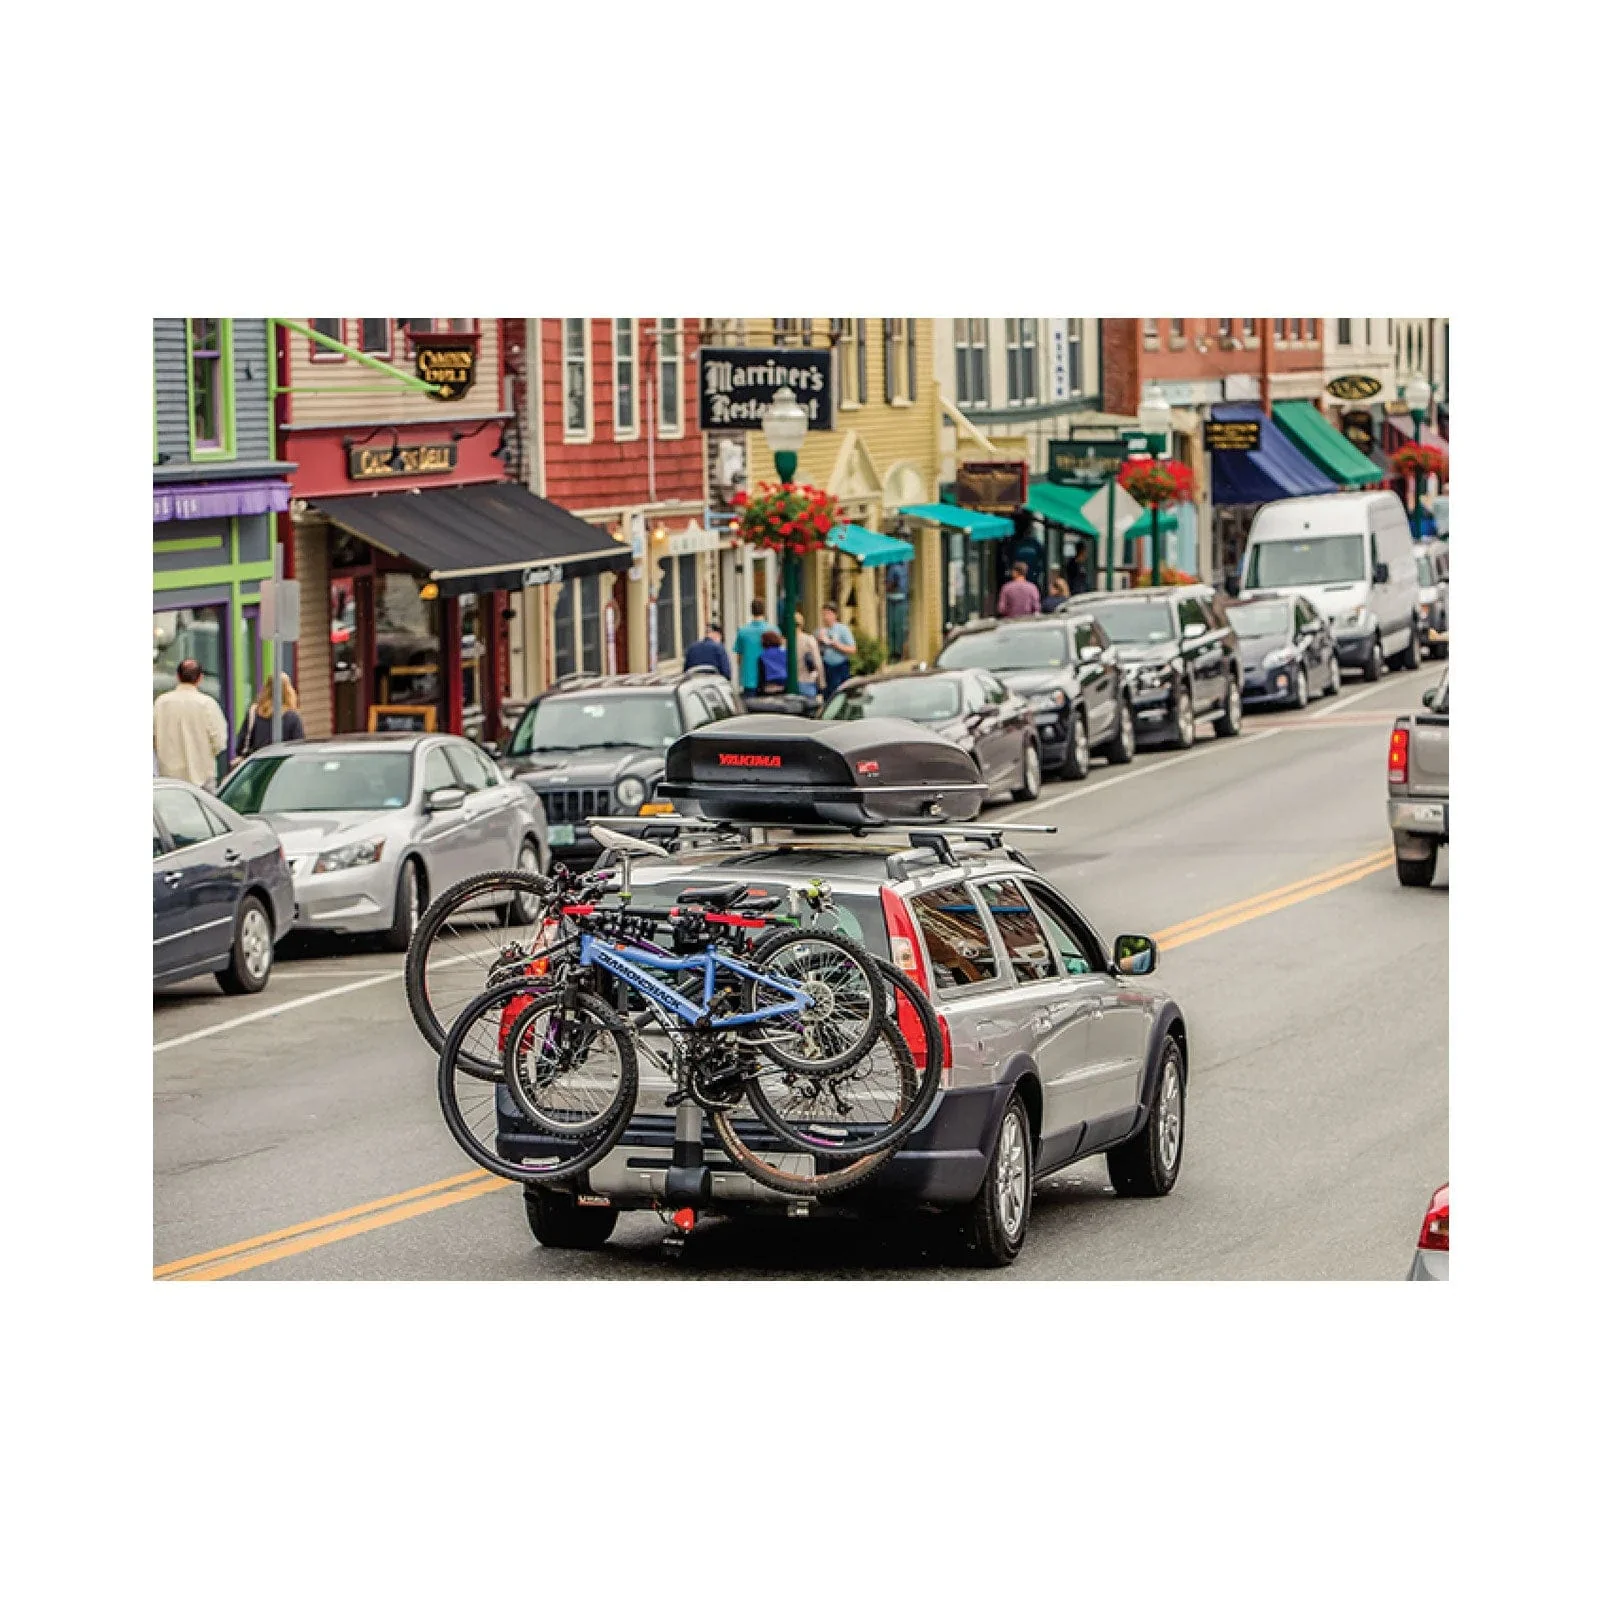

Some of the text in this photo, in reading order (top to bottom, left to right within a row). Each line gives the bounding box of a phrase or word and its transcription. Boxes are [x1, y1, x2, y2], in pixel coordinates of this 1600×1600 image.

[703, 359, 824, 395] Marriner's
[718, 753, 781, 768] YAKIMA
[598, 951, 683, 1009] DIAMONDBACK
